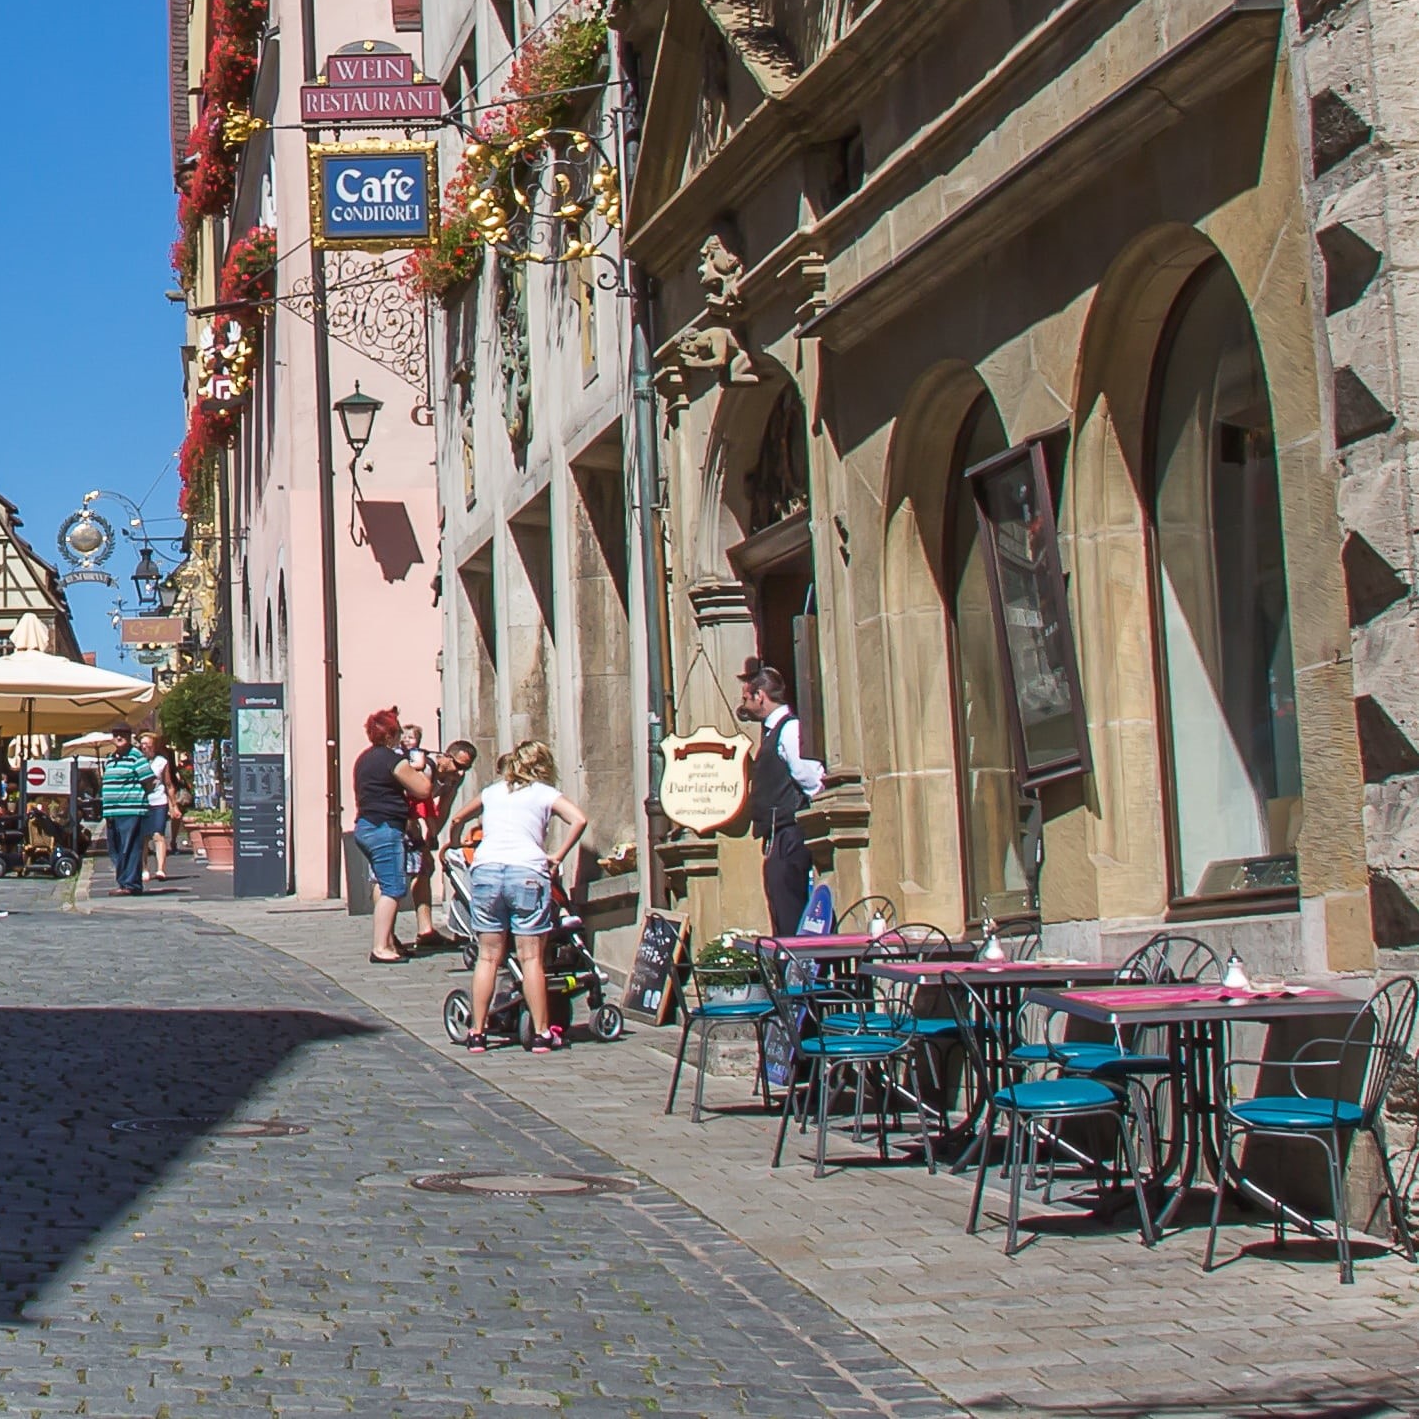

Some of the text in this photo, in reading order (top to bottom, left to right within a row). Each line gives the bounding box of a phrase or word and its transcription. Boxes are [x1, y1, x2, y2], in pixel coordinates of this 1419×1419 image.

[334, 59, 405, 81] WEIN
[305, 89, 438, 114] RESTAURANT
[335, 167, 415, 204] Cafe
[330, 204, 421, 223] CONDITOREI
[666, 781, 740, 798] Patrizierhof
